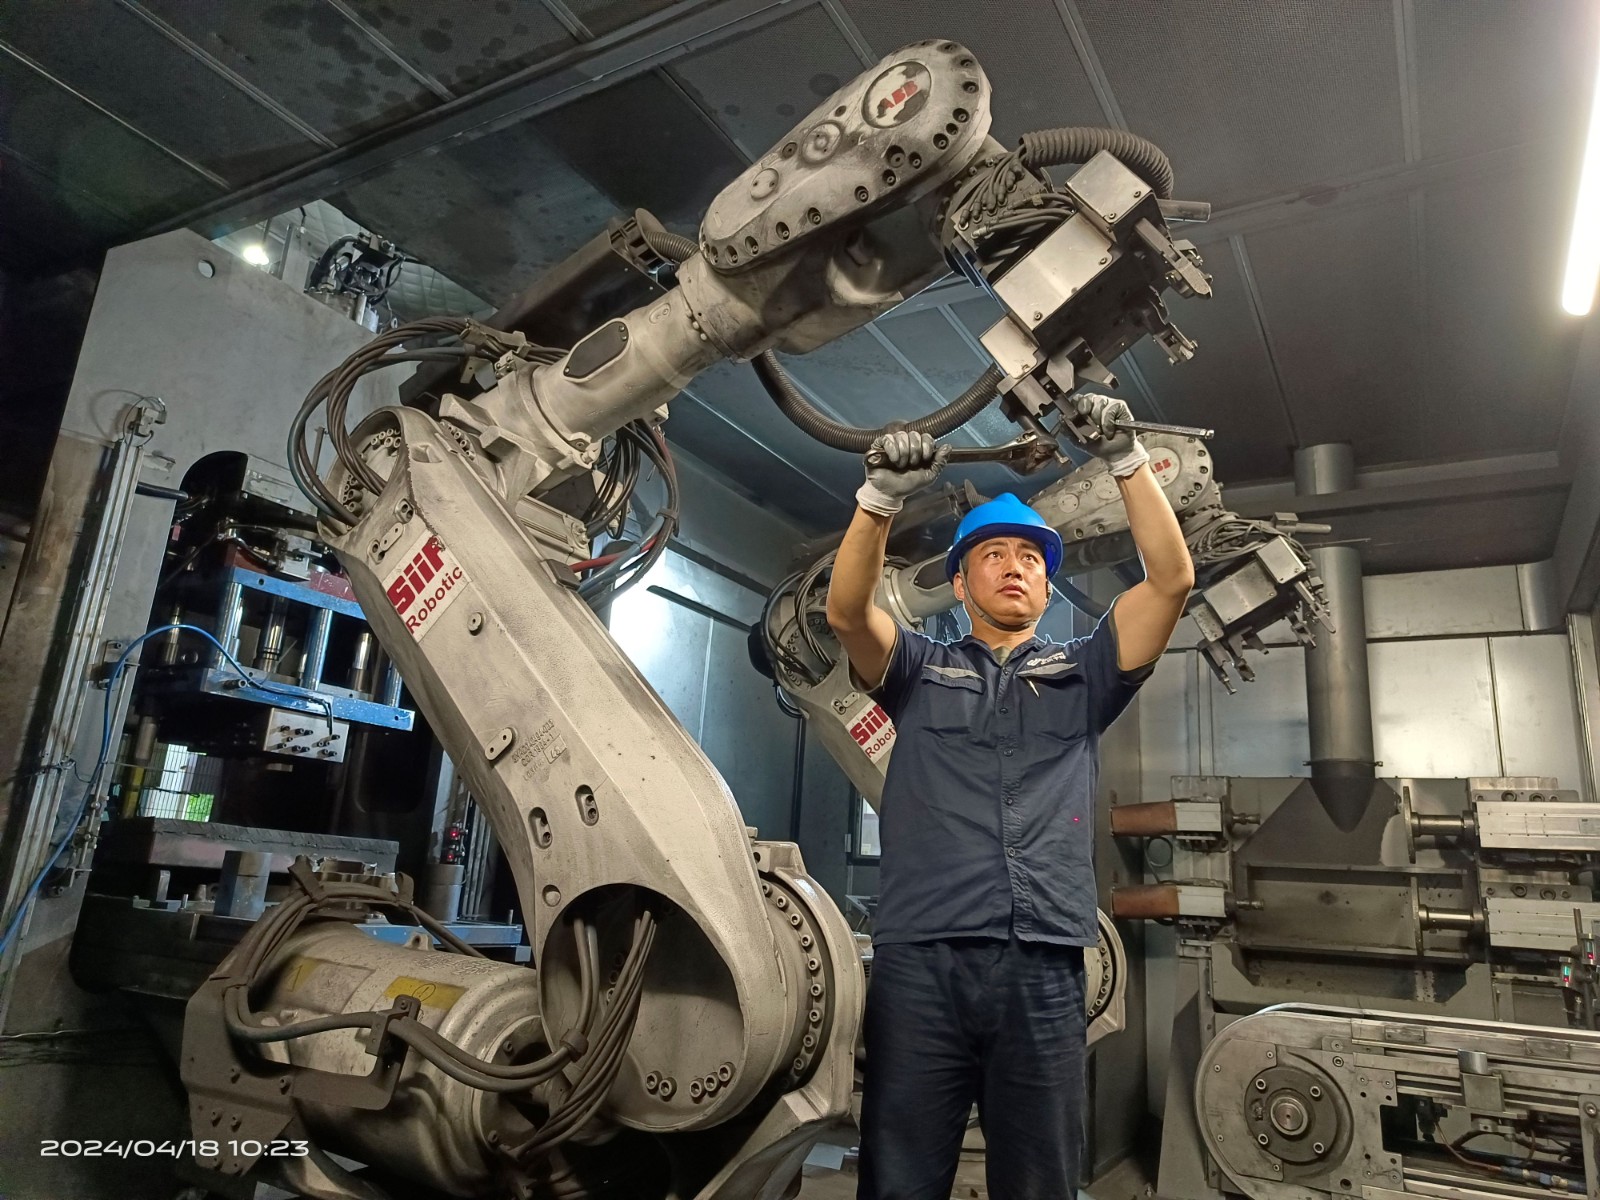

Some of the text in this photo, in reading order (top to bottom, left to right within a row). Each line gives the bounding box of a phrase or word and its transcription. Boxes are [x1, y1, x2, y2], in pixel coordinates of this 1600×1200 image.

[877, 80, 918, 118] ABB
[1151, 458, 1172, 474] BB
[405, 566, 463, 634] Robotic
